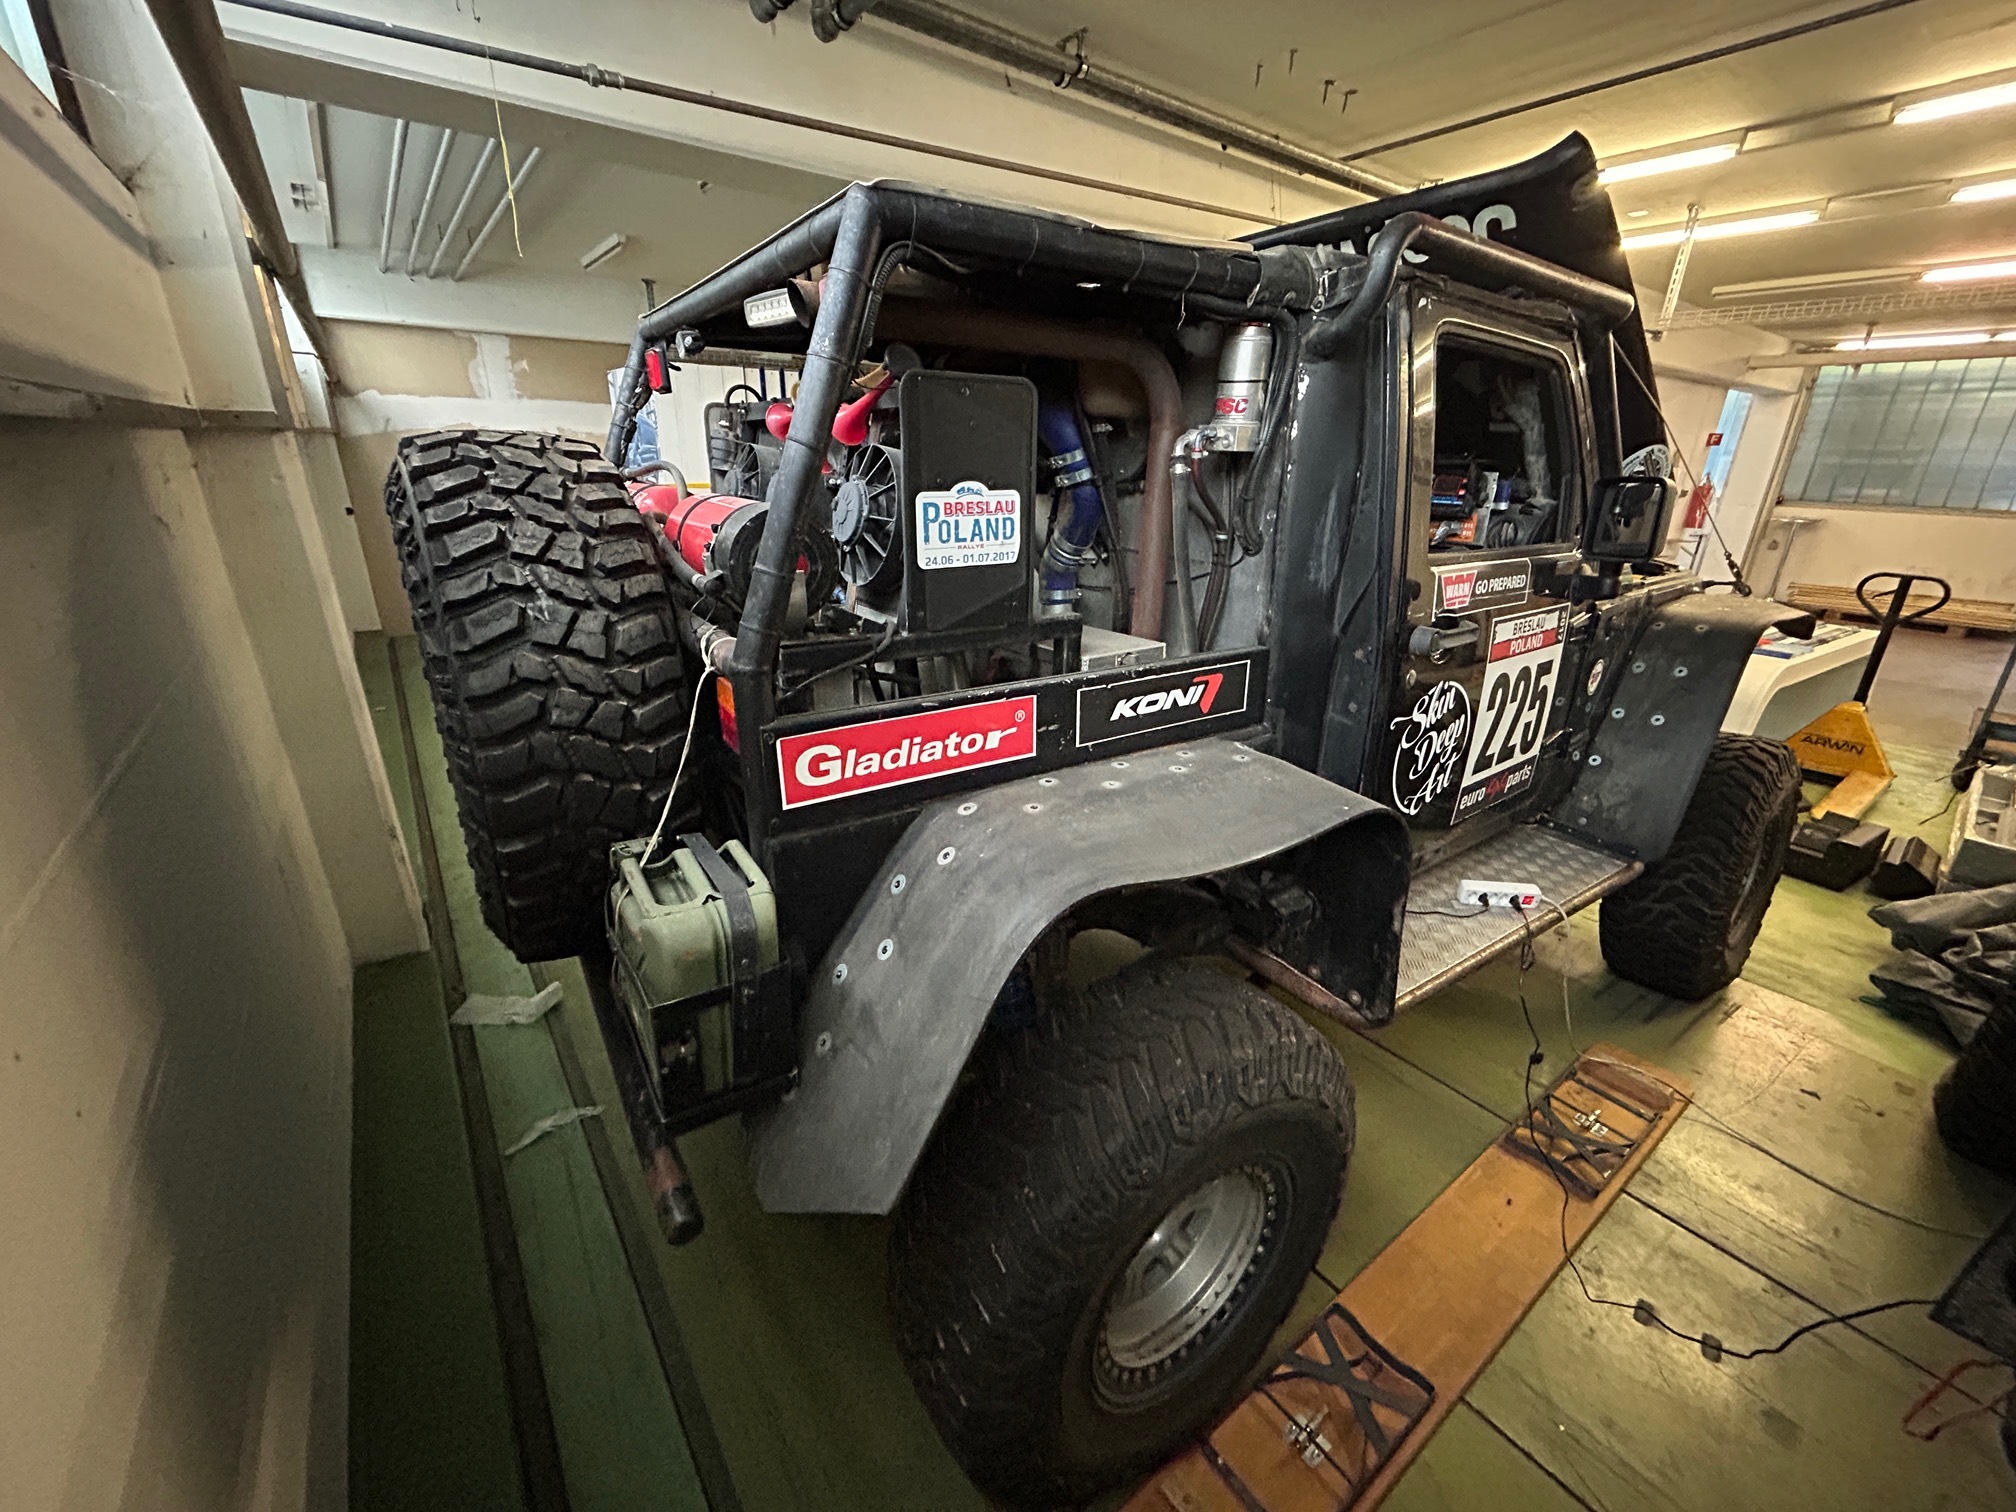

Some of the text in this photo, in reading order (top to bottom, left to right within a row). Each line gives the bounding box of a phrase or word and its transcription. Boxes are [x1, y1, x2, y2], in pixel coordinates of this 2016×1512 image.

[922, 502, 1016, 545] POLAND
[943, 500, 1016, 517] BRESLAU
[925, 555, 954, 567] 24.06
[962, 551, 1016, 564] 01.07.2017
[1446, 574, 1527, 599] WARN GO PREPARED
[1512, 616, 1546, 636] BRESLAU
[1509, 634, 1544, 656] POLAND
[1390, 680, 1457, 749] Skin
[1471, 659, 1554, 776] 225
[1409, 713, 1466, 780] Deep
[1404, 752, 1464, 816] Art
